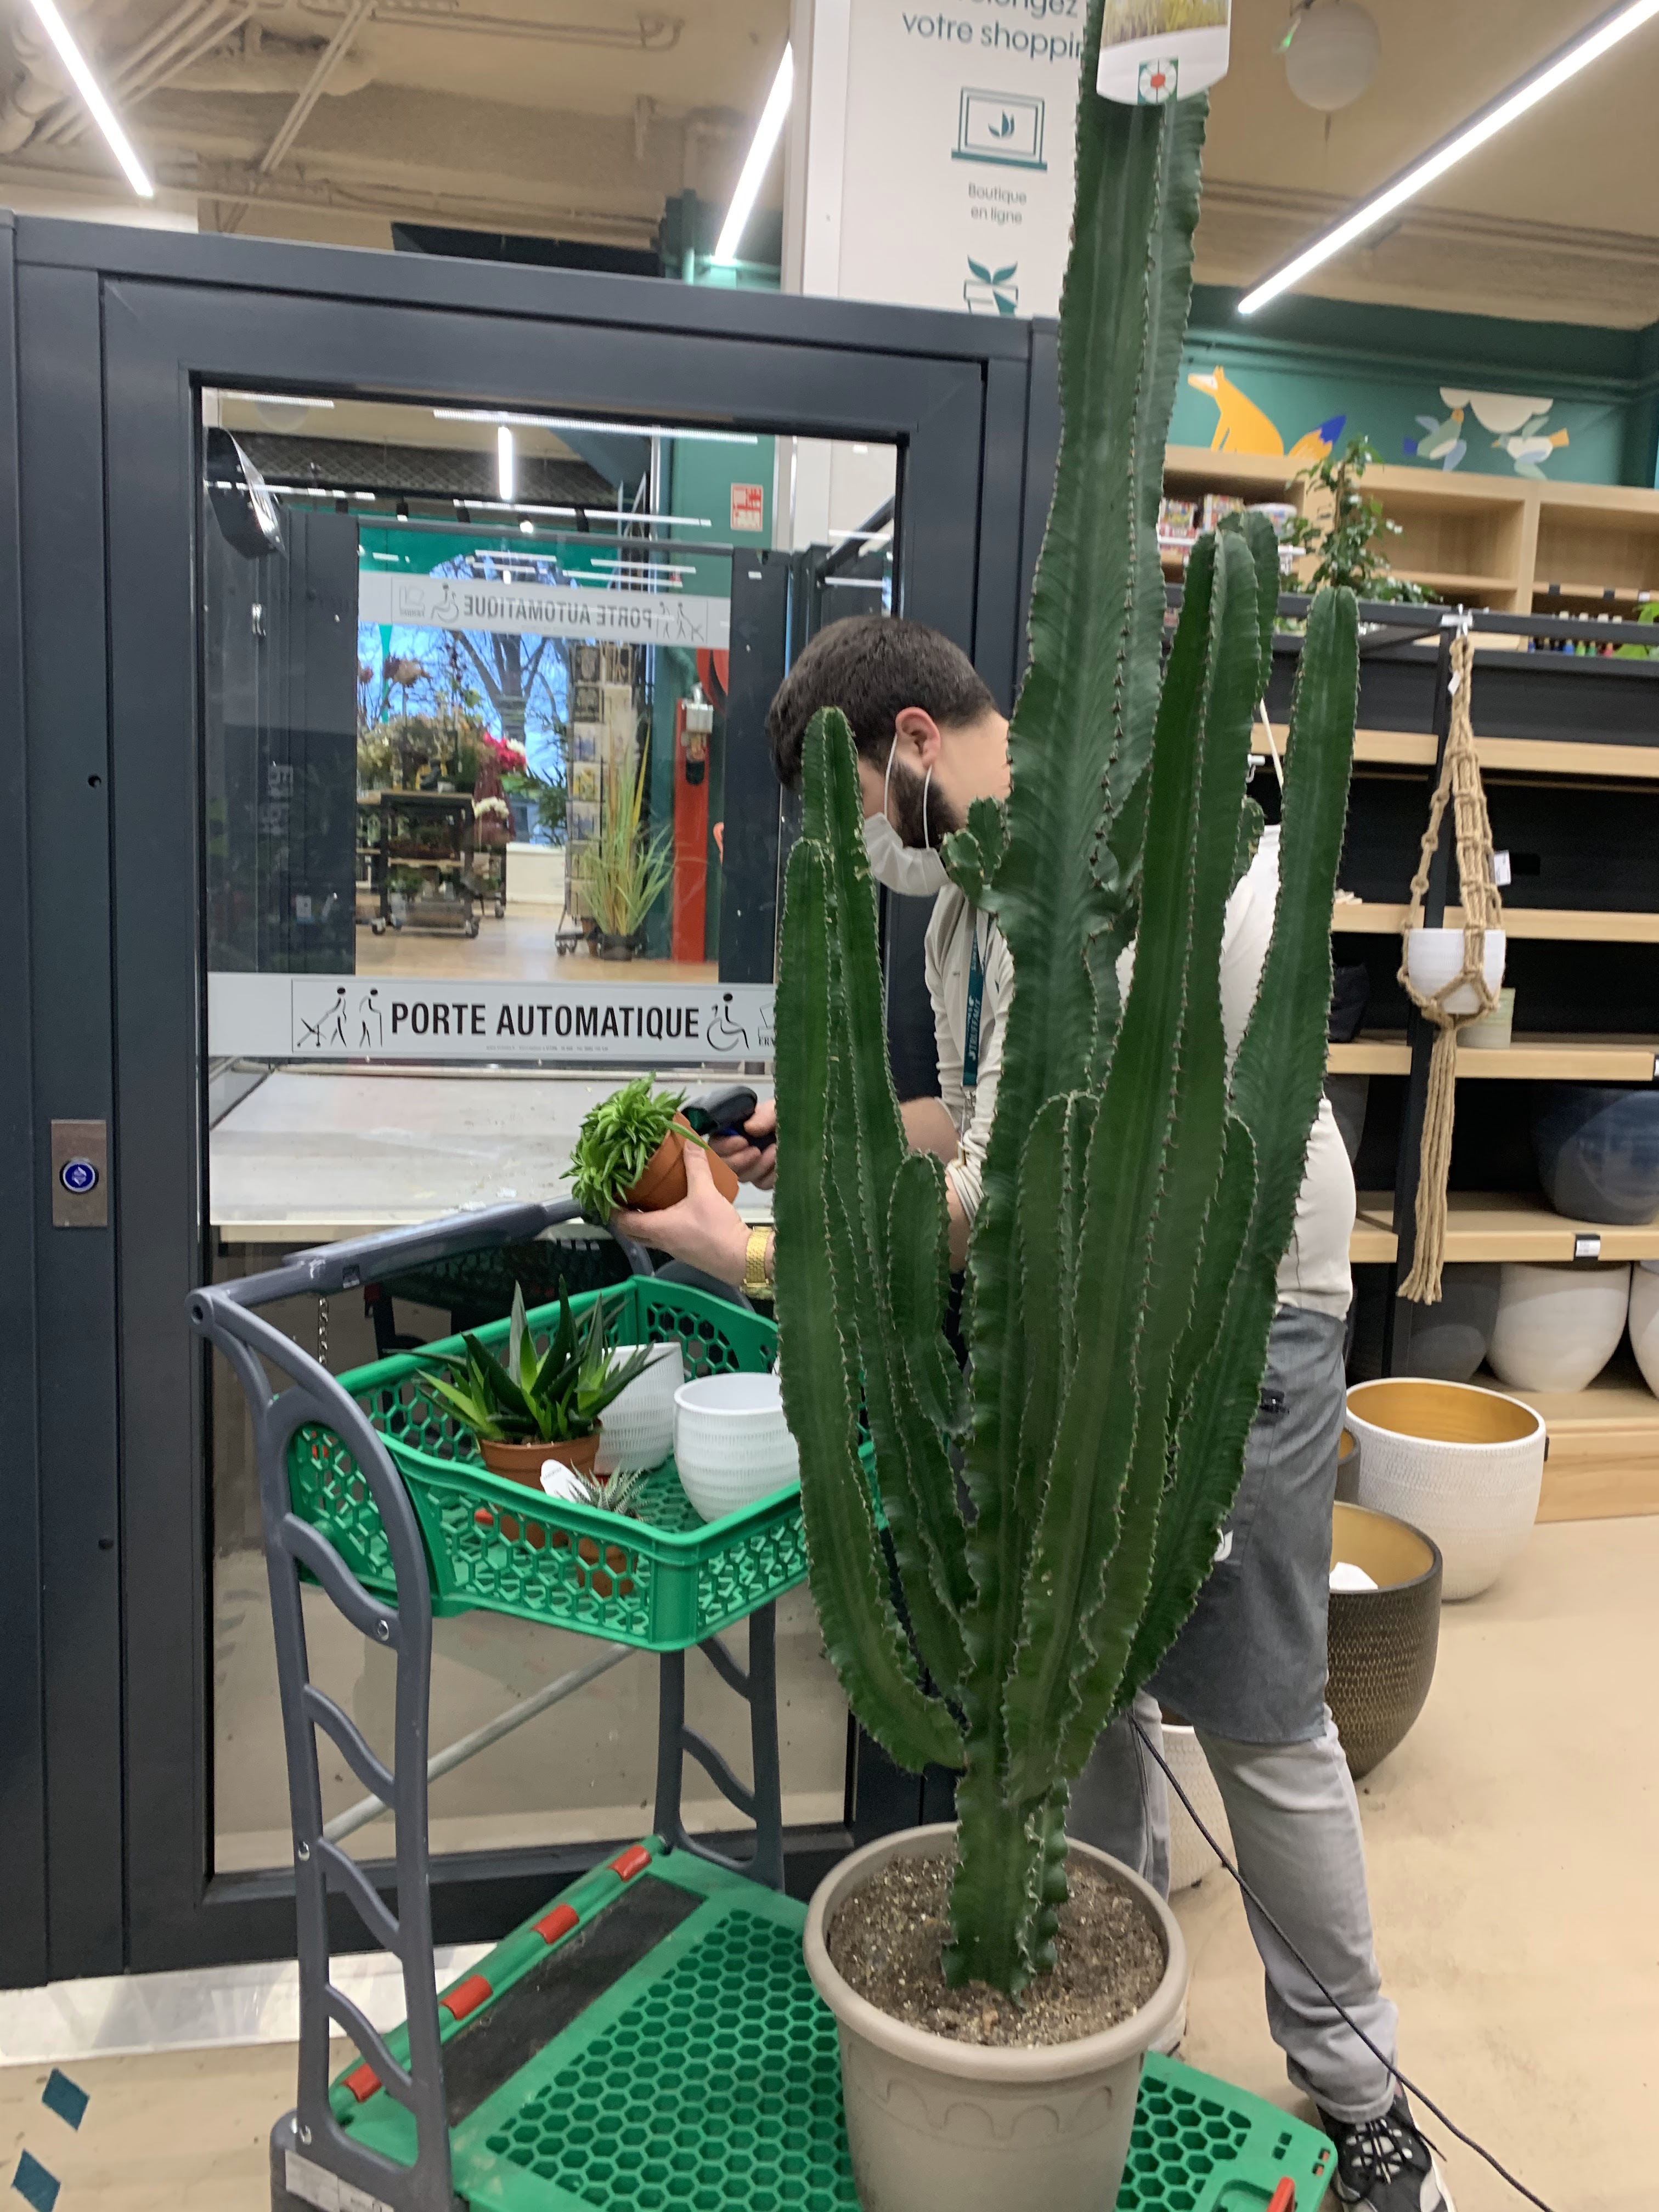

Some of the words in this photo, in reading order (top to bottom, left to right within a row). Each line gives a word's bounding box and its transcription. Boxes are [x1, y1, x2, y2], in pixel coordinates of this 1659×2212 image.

[902, 13, 973, 44] votre
[968, 182, 1026, 206] Boutique
[971, 206, 988, 219] en
[991, 206, 1023, 225] ligne
[392, 1002, 486, 1036] PORTE
[496, 1004, 699, 1041] AUTOMATIQUE
